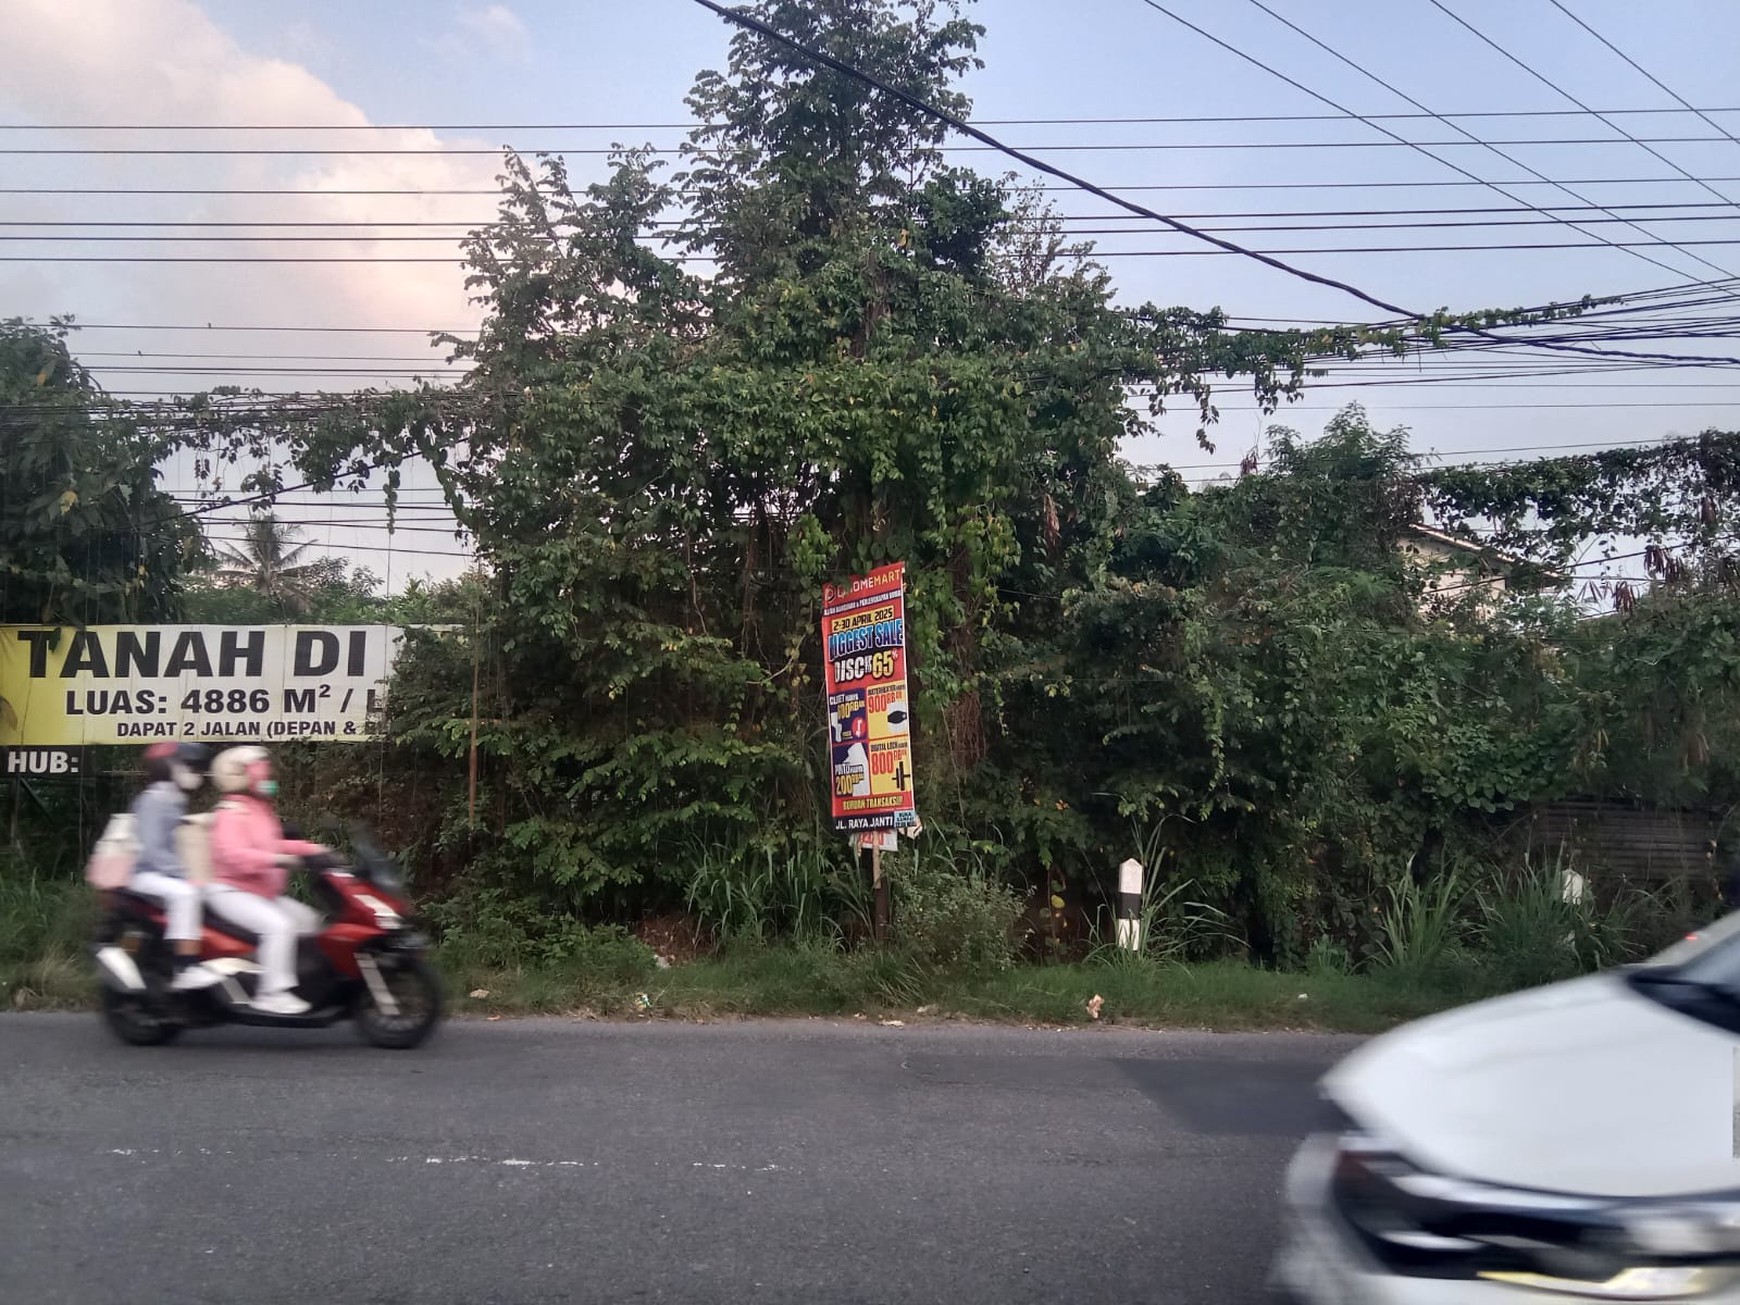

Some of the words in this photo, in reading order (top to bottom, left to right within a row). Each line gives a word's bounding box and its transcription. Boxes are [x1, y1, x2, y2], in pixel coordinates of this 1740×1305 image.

[837, 569, 901, 599] QOMEMART
[833, 619, 851, 631] 2-30
[852, 614, 873, 626] APRIL
[874, 607, 893, 620] 2025
[874, 618, 904, 648] SALE
[17, 630, 265, 679] TANAH
[293, 630, 368, 677] DI
[834, 656, 865, 683] DISC
[66, 689, 168, 716] LUAS:
[180, 688, 270, 714] 4886
[117, 721, 178, 738] DAPAT
[183, 721, 196, 736] 2
[200, 721, 261, 737] JALAN
[266, 721, 336, 738] (DEPAN
[343, 721, 357, 736] &
[7, 750, 80, 774] HUB:
[871, 751, 893, 775] 800
[835, 774, 852, 796] 200
[835, 820, 847, 830] JL.
[848, 818, 869, 829] RAYA
[869, 815, 894, 828] JANTI
